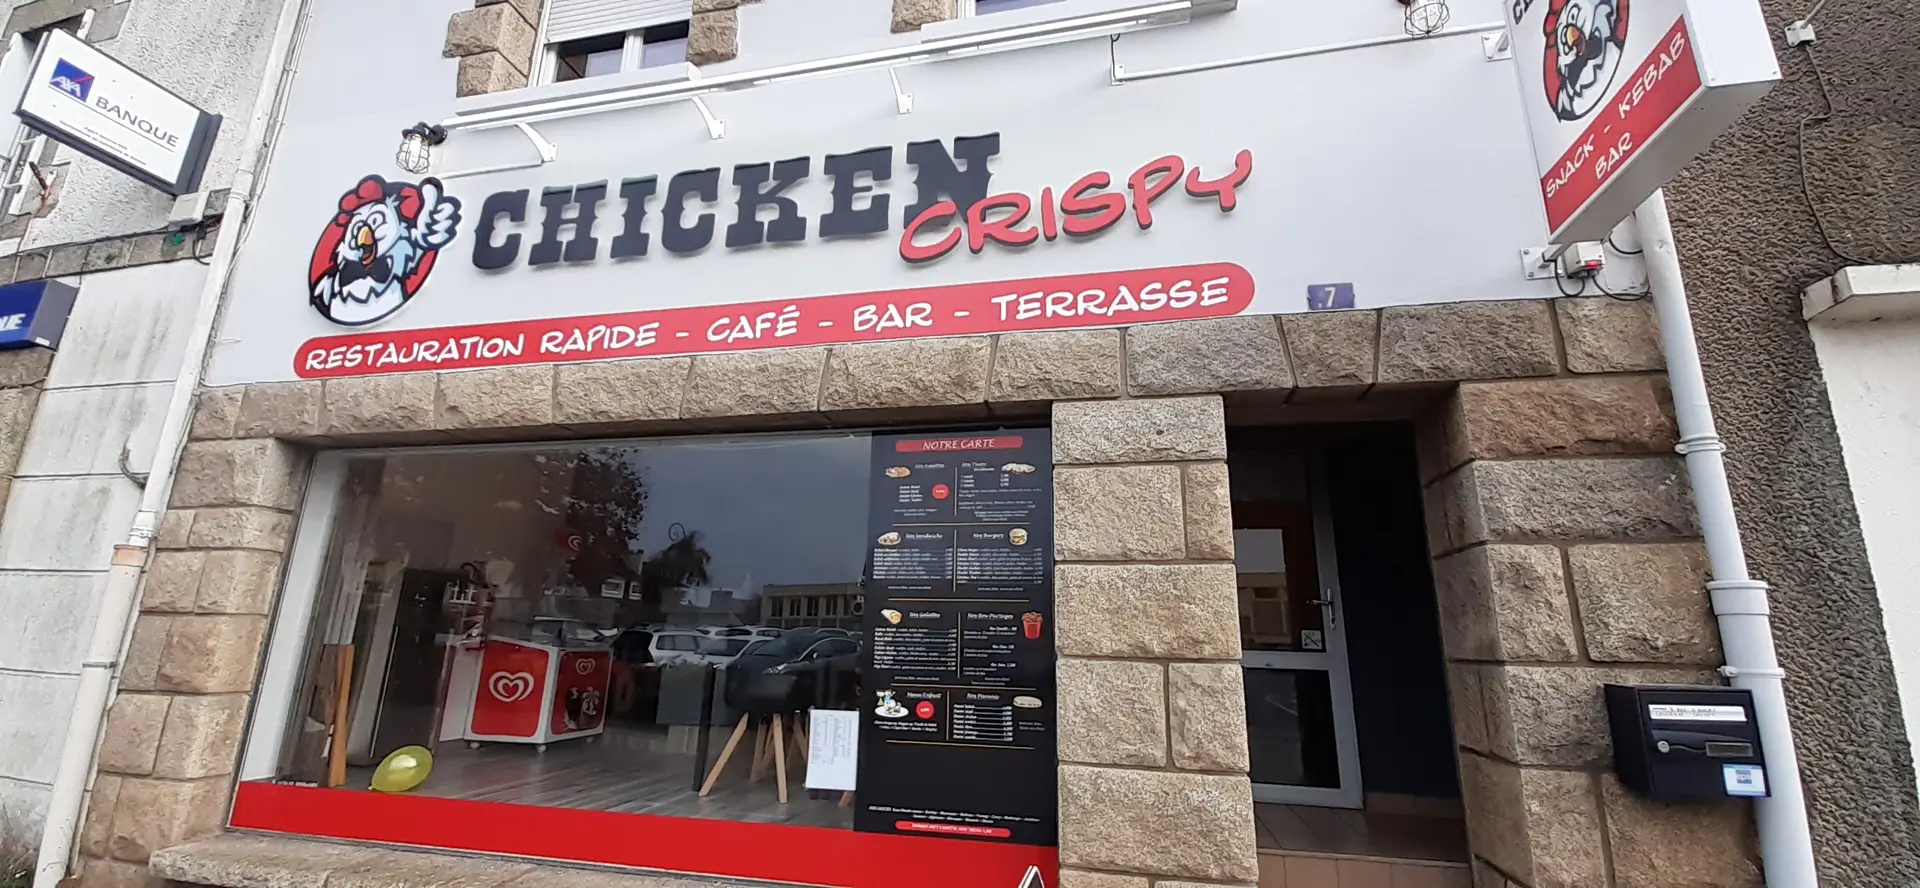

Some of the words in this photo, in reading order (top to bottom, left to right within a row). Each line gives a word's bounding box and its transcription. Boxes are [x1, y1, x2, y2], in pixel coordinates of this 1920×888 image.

[96, 96, 179, 147] BANQUE
[1545, 134, 1595, 198] SNACK
[1618, 32, 1685, 119] KEBAB
[1594, 132, 1632, 180] BAR
[471, 131, 1000, 270] CHICKEN
[899, 148, 1252, 263] CRISPY
[305, 334, 525, 370] RESTAURATION
[540, 322, 660, 355] RAPIDE
[706, 305, 800, 343] CAFÉ
[853, 300, 934, 333] BAR
[991, 276, 1230, 321] TERRASSE
[1325, 286, 1336, 308] 7
[923, 440, 959, 450] NOTRE
[961, 438, 996, 449] CARTE
